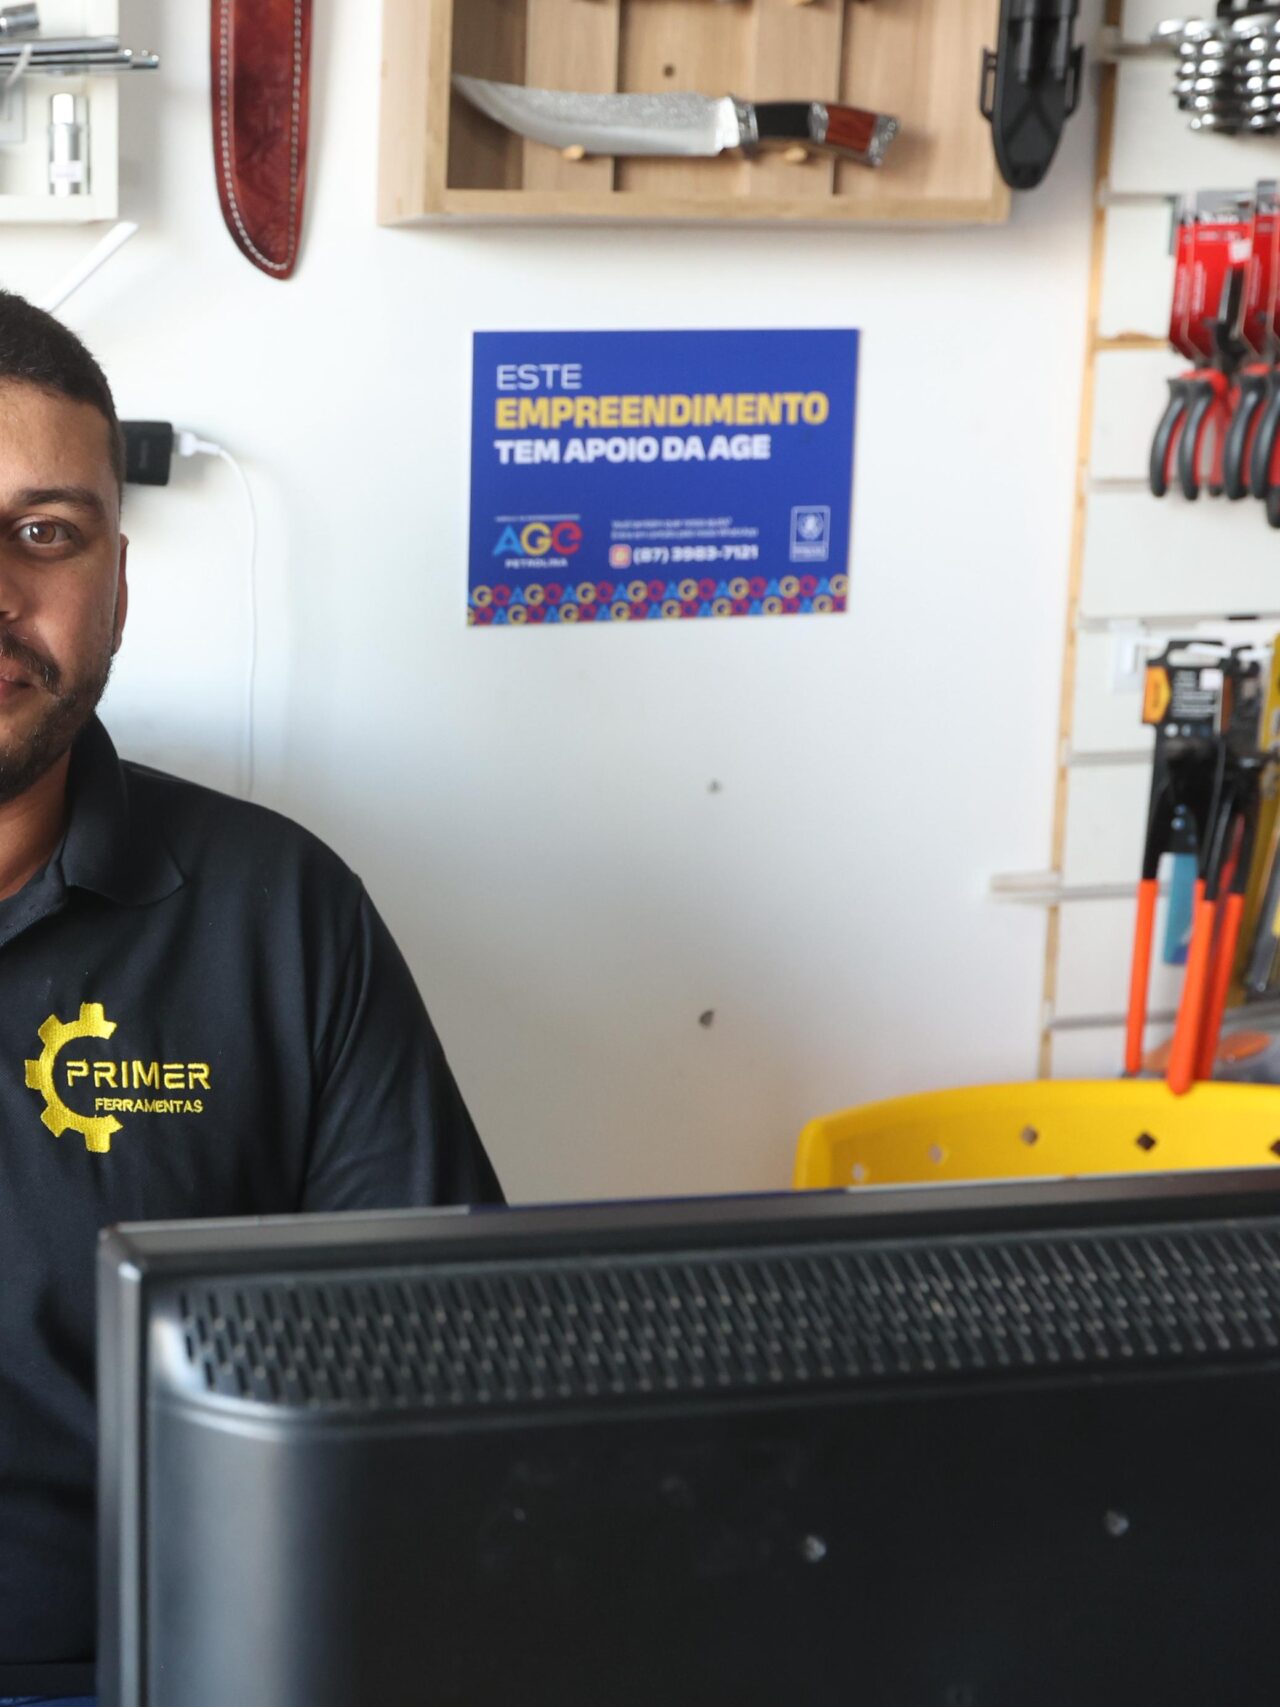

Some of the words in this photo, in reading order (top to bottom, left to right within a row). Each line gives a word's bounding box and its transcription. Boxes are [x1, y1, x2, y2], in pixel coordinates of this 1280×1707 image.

[496, 364, 582, 390] ESTE
[495, 392, 829, 429] EMPREENDIMENTO
[494, 438, 560, 464] TEM
[564, 437, 659, 463] APOIO
[661, 436, 705, 461] DA
[708, 434, 771, 460] AGE
[66, 1060, 212, 1090] PRIMER
[94, 1097, 204, 1114] FERRAMENTAS
